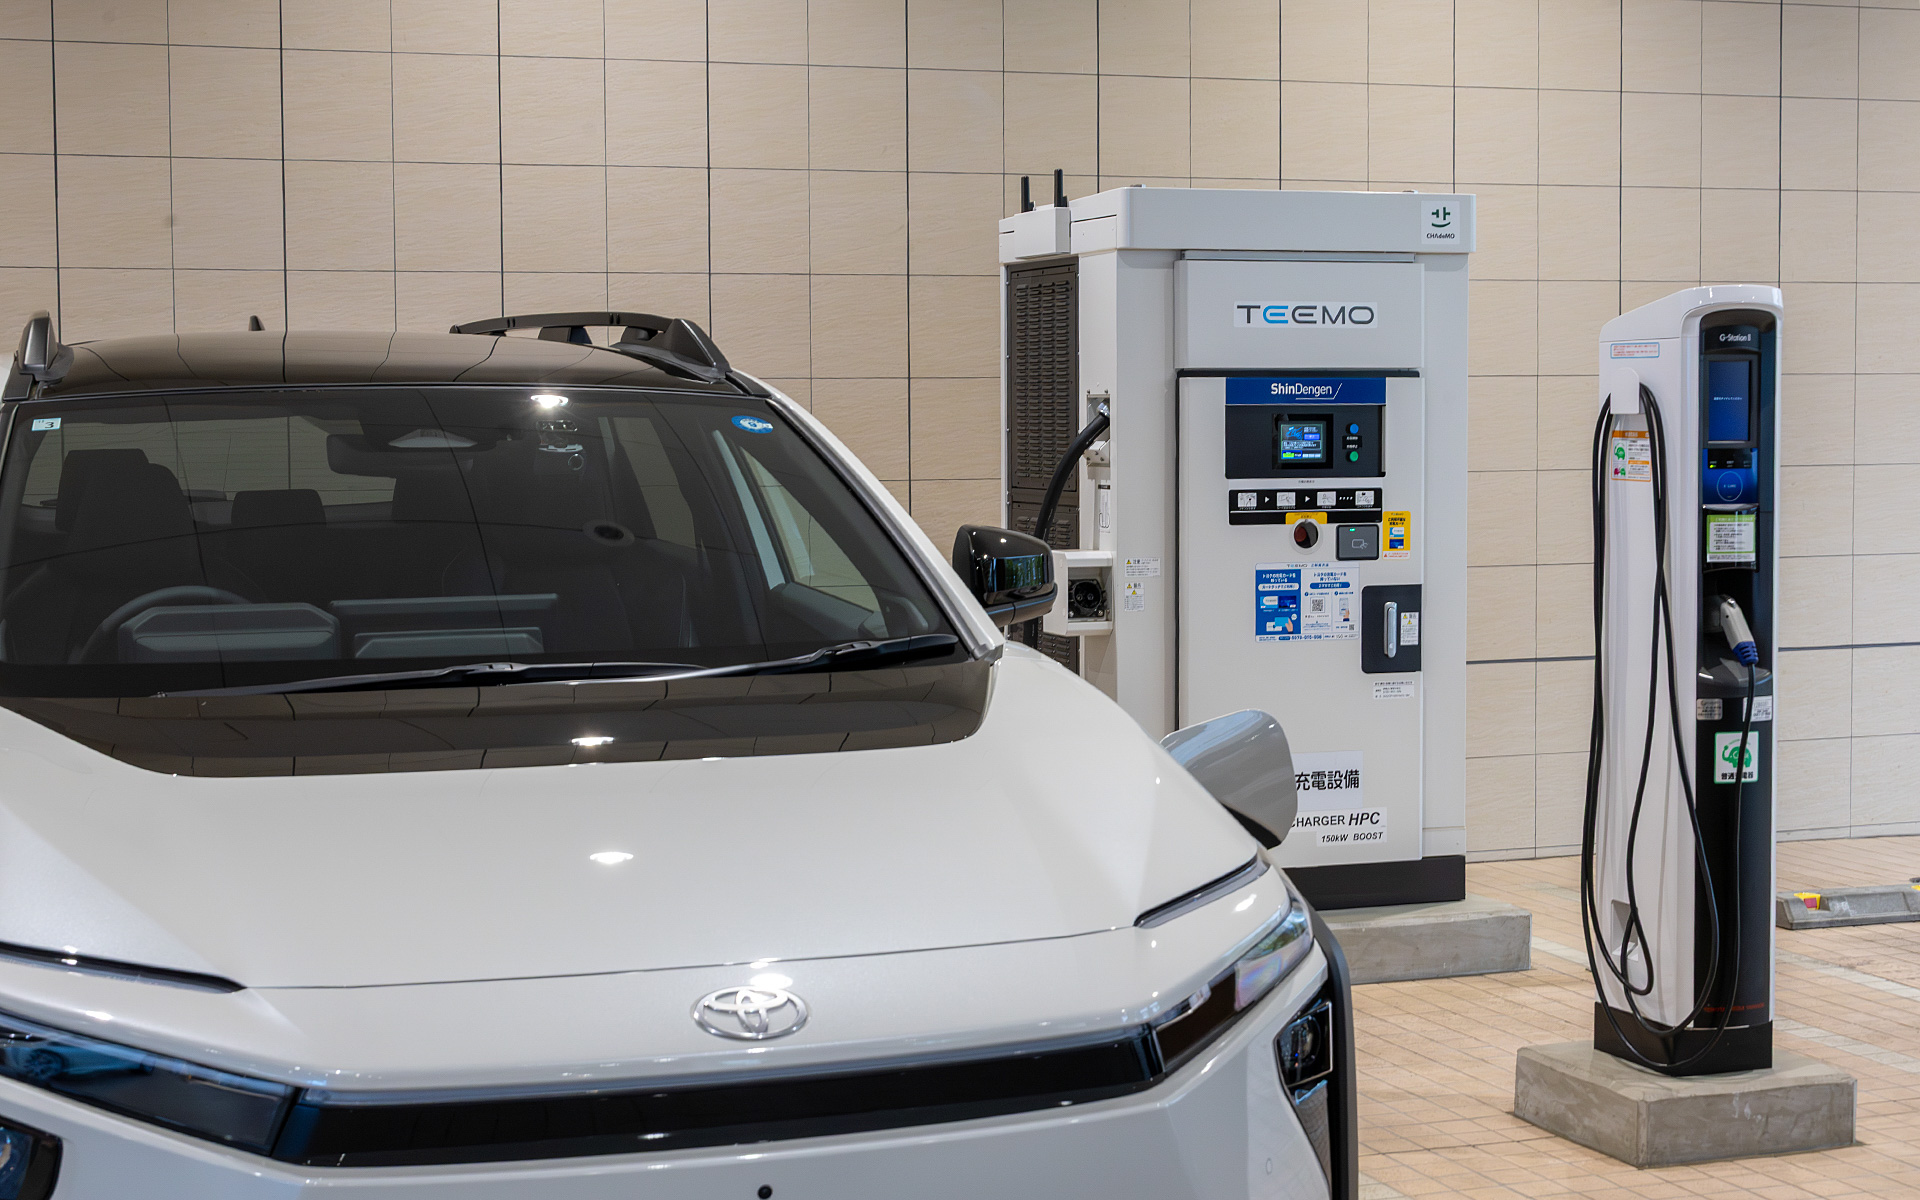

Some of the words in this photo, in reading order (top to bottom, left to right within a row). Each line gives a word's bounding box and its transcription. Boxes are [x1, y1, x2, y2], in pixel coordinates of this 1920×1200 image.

[1237, 305, 1374, 325] TEEMO
[1719, 333, 1747, 342] G-Station
[1271, 383, 1332, 397] ShinDengen
[1295, 769, 1360, 790] 充電設備
[1721, 772, 1753, 780] 普通電器
[1292, 815, 1345, 827] HARGER
[1348, 811, 1380, 826] HPC
[1321, 834, 1348, 843] 150kW
[1353, 831, 1384, 841] BOOST
